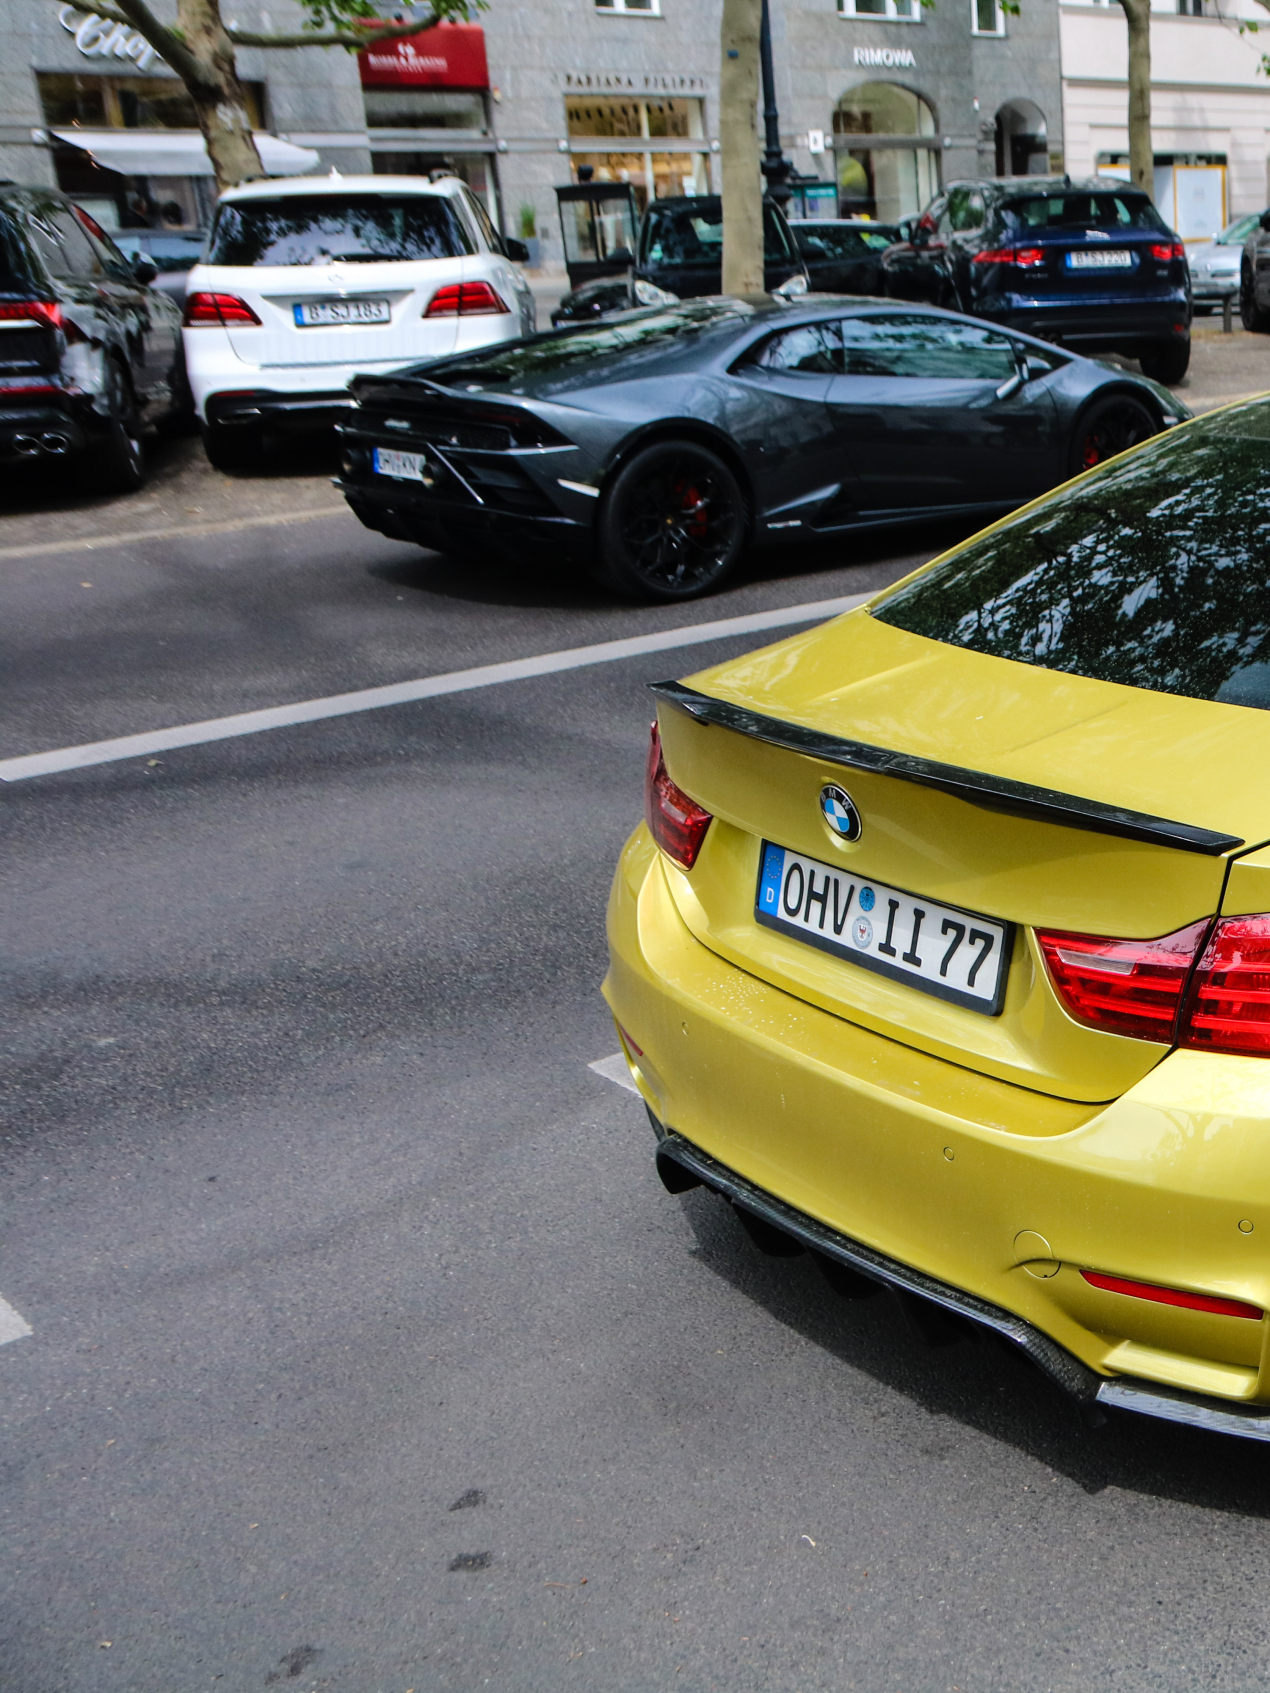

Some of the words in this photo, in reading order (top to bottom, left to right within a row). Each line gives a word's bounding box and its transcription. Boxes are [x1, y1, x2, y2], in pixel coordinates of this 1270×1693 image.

[59, 4, 164, 72] Chop
[853, 46, 917, 68] RIMOWA
[765, 887, 775, 903] D
[783, 862, 855, 935] OHV
[878, 898, 926, 968] II
[939, 918, 995, 988] 77
